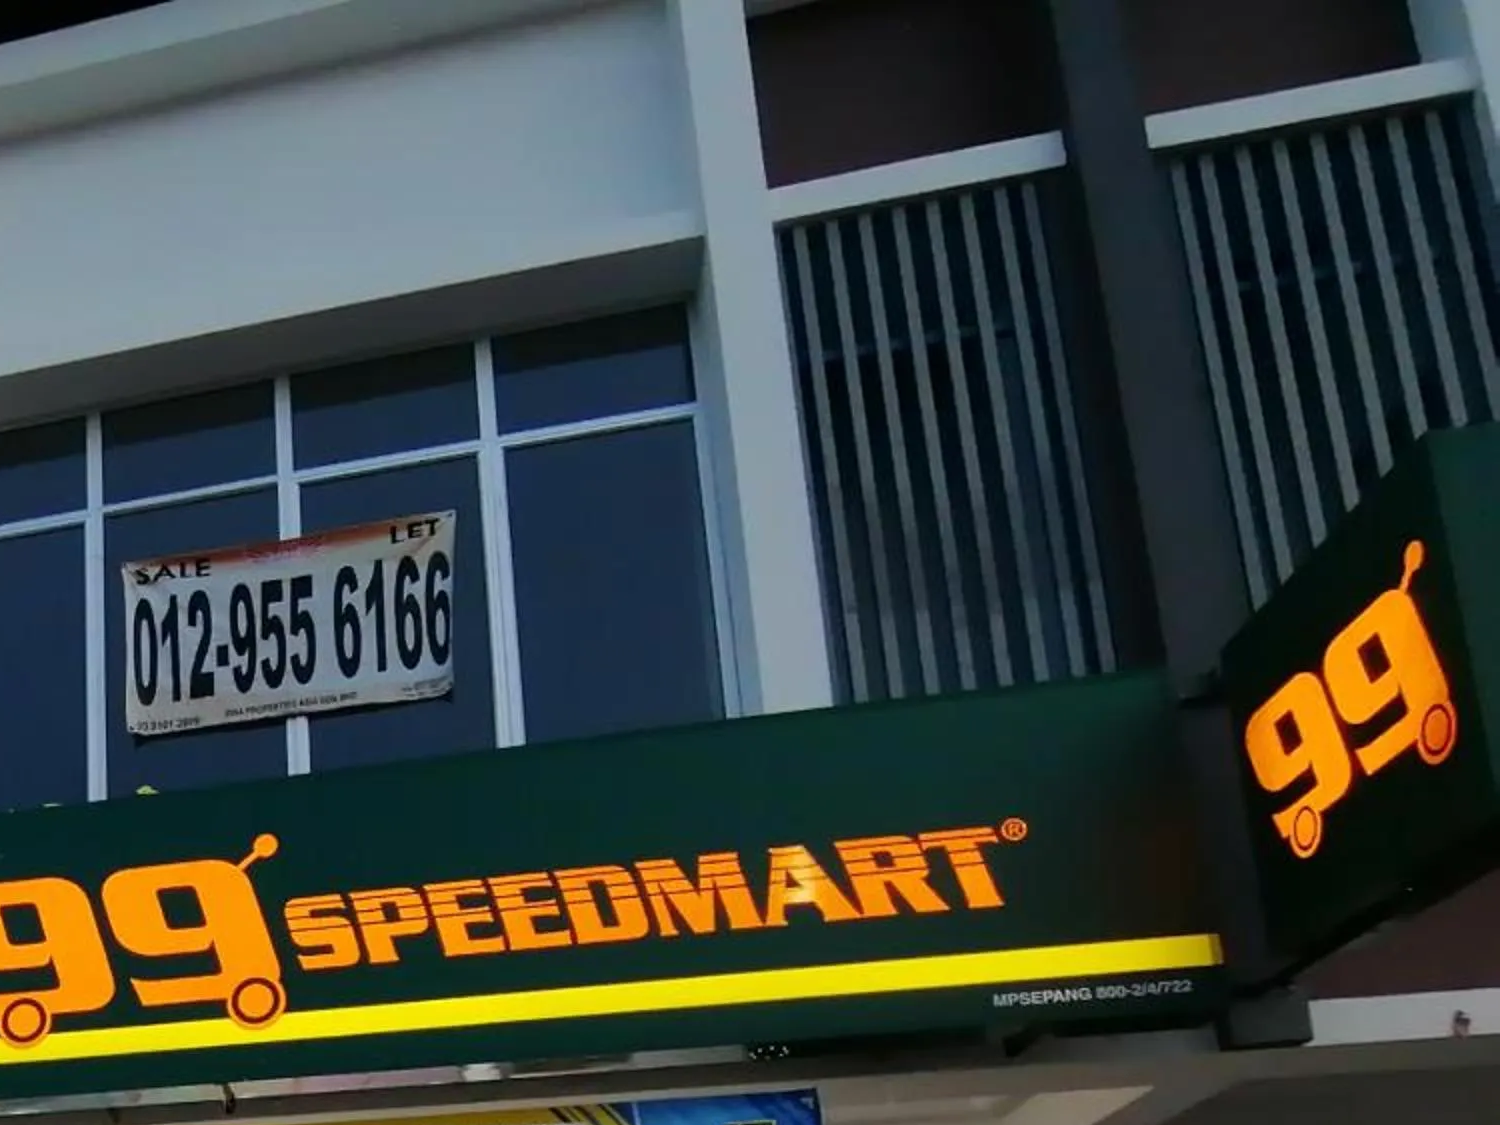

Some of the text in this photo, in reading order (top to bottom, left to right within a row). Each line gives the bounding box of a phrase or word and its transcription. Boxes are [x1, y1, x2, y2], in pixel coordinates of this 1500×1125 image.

[134, 558, 212, 586] SALE
[389, 518, 440, 544] LET
[133, 551, 451, 706] 012-955 6166
[1244, 588, 1457, 859] 99
[284, 827, 1005, 971] SPEEDMART
[993, 987, 1092, 1008] MPSEPANG
